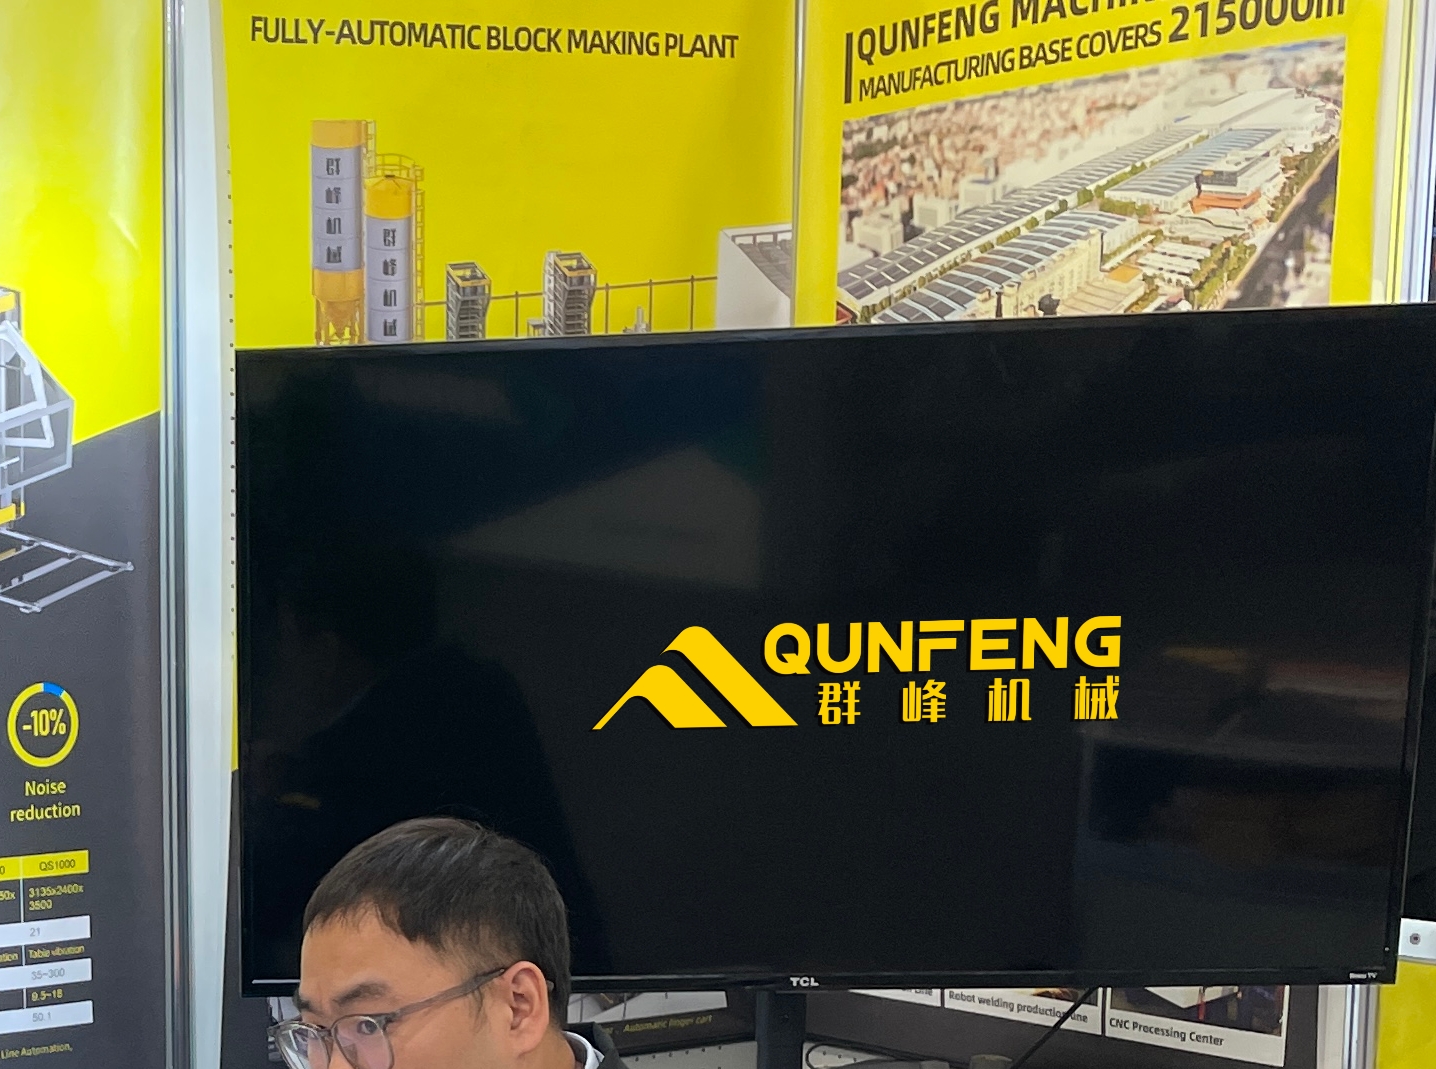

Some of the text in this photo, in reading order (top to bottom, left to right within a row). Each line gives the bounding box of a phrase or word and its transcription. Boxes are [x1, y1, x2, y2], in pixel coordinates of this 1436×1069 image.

[251, 15, 739, 59] FULLY-AUTOMATIC BLOCK MAKING PLANT
[858, 0, 999, 65] QUNFENG
[859, 48, 1014, 101] MANUFACTURING
[1019, 37, 1073, 69] BASE
[1077, 20, 1161, 59] COVERS
[764, 615, 1122, 675] QUNFENG
[818, 675, 1120, 725] 群峰机械
[22, 709, 66, 737] -10%
[24, 779, 66, 797] Noise
[9, 802, 81, 823] reduction
[39, 859, 76, 872] QS1000
[29, 927, 41, 937] 21
[789, 977, 820, 987] TCL
[949, 990, 976, 1003] Robot
[978, 995, 1014, 1012] welding
[1109, 1017, 1224, 1046] CNC Processing Center
